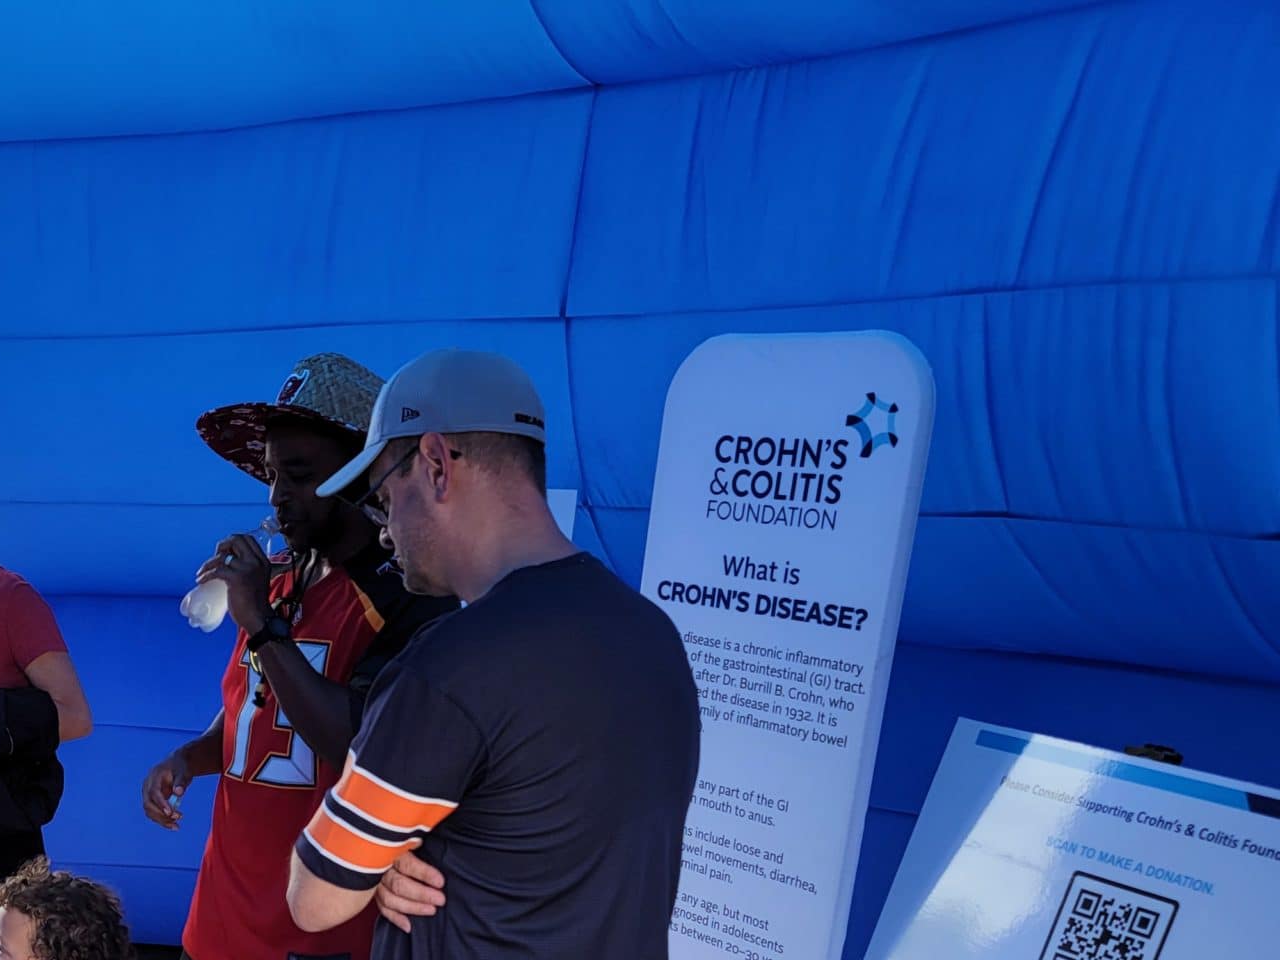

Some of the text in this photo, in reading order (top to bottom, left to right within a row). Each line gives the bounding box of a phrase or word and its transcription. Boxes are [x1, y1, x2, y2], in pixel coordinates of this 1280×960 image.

[714, 435, 849, 470] CROHN'S
[706, 499, 838, 530] FOUNDATION
[722, 554, 801, 585] What is
[657, 580, 869, 631] CROHN'S DISEASE?
[683, 631, 864, 678] disease is a chronic inflammatory
[690, 650, 866, 695] of the gastrointestinal (GI) tract.
[695, 669, 855, 712] after Dr. Burrill B. Crohn, who
[711, 690, 728, 704] the
[730, 693, 770, 713] disease
[772, 702, 782, 715] in
[785, 705, 814, 722] 1932.
[816, 711, 826, 725] It
[827, 714, 838, 728] is
[700, 704, 848, 748] mily of inflammatory bowel
[698, 780, 789, 813] any part of the GI
[699, 796, 732, 814] mouth
[734, 804, 746, 818] to
[748, 810, 776, 827] anus.
[1076, 796, 1135, 823] Supporting
[1136, 811, 1183, 833] Crohn's
[1184, 823, 1195, 837] &
[1199, 827, 1239, 849] Colitis
[694, 827, 731, 848] include
[733, 838, 761, 858] loose
[763, 850, 784, 865] and
[1045, 836, 1215, 896] SCAN TO MAKE A DONATION.
[705, 849, 767, 879] movements,
[769, 868, 818, 895] diarrhea,
[709, 867, 733, 884] pain.
[673, 907, 709, 927] gnosed
[711, 917, 720, 930] in
[722, 924, 785, 955] adolescents
[681, 892, 769, 932] any age, but most
[681, 923, 723, 950] between
